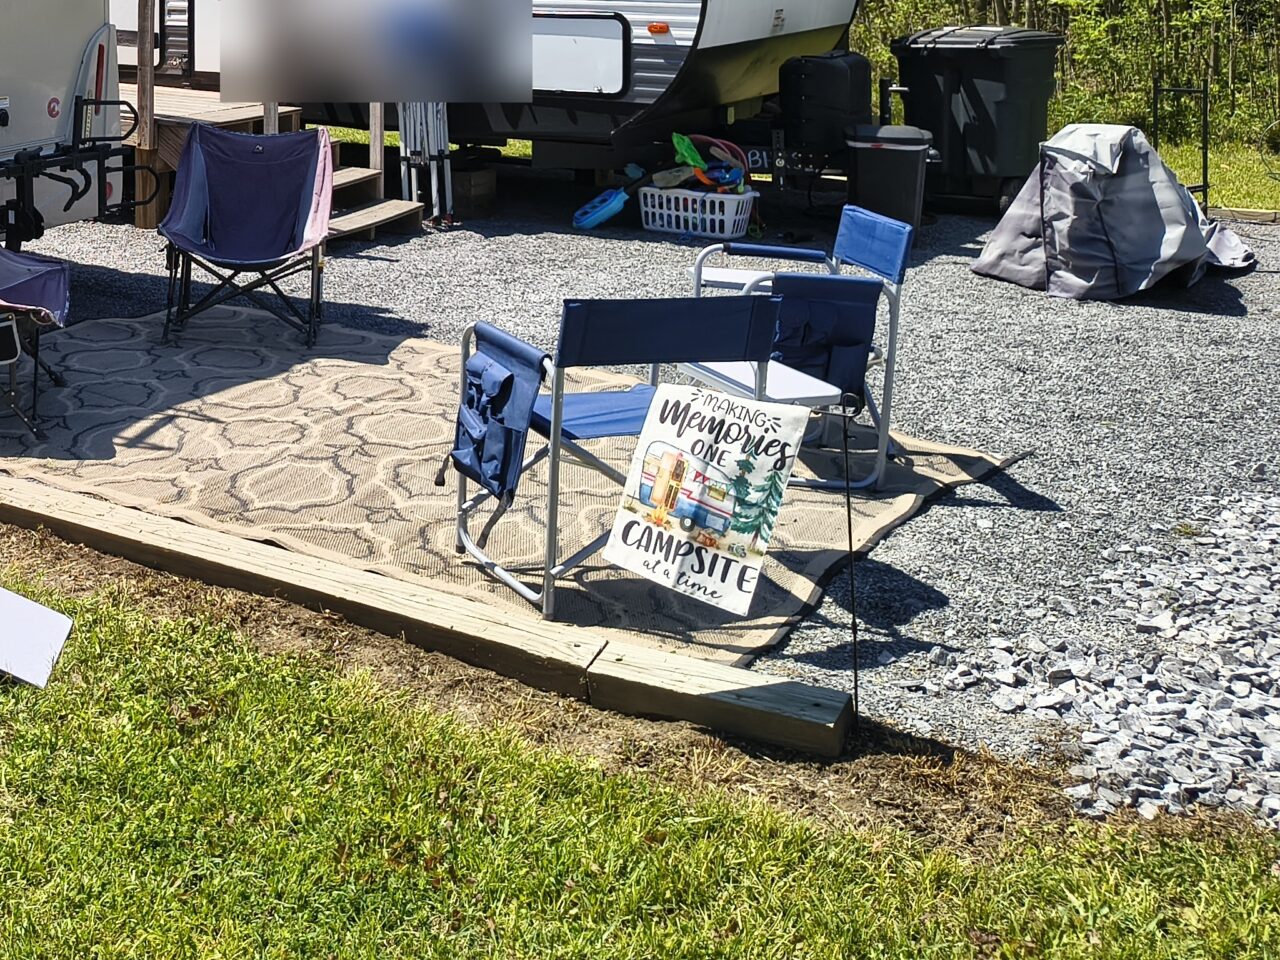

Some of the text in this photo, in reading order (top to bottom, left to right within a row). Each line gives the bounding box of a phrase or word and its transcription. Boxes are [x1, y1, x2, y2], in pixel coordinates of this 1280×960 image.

[702, 393, 768, 427] MAKING
[659, 398, 796, 471] Memories
[691, 439, 733, 467] ONE
[621, 520, 759, 594] CAMPSITE
[642, 558, 723, 600] at a time
